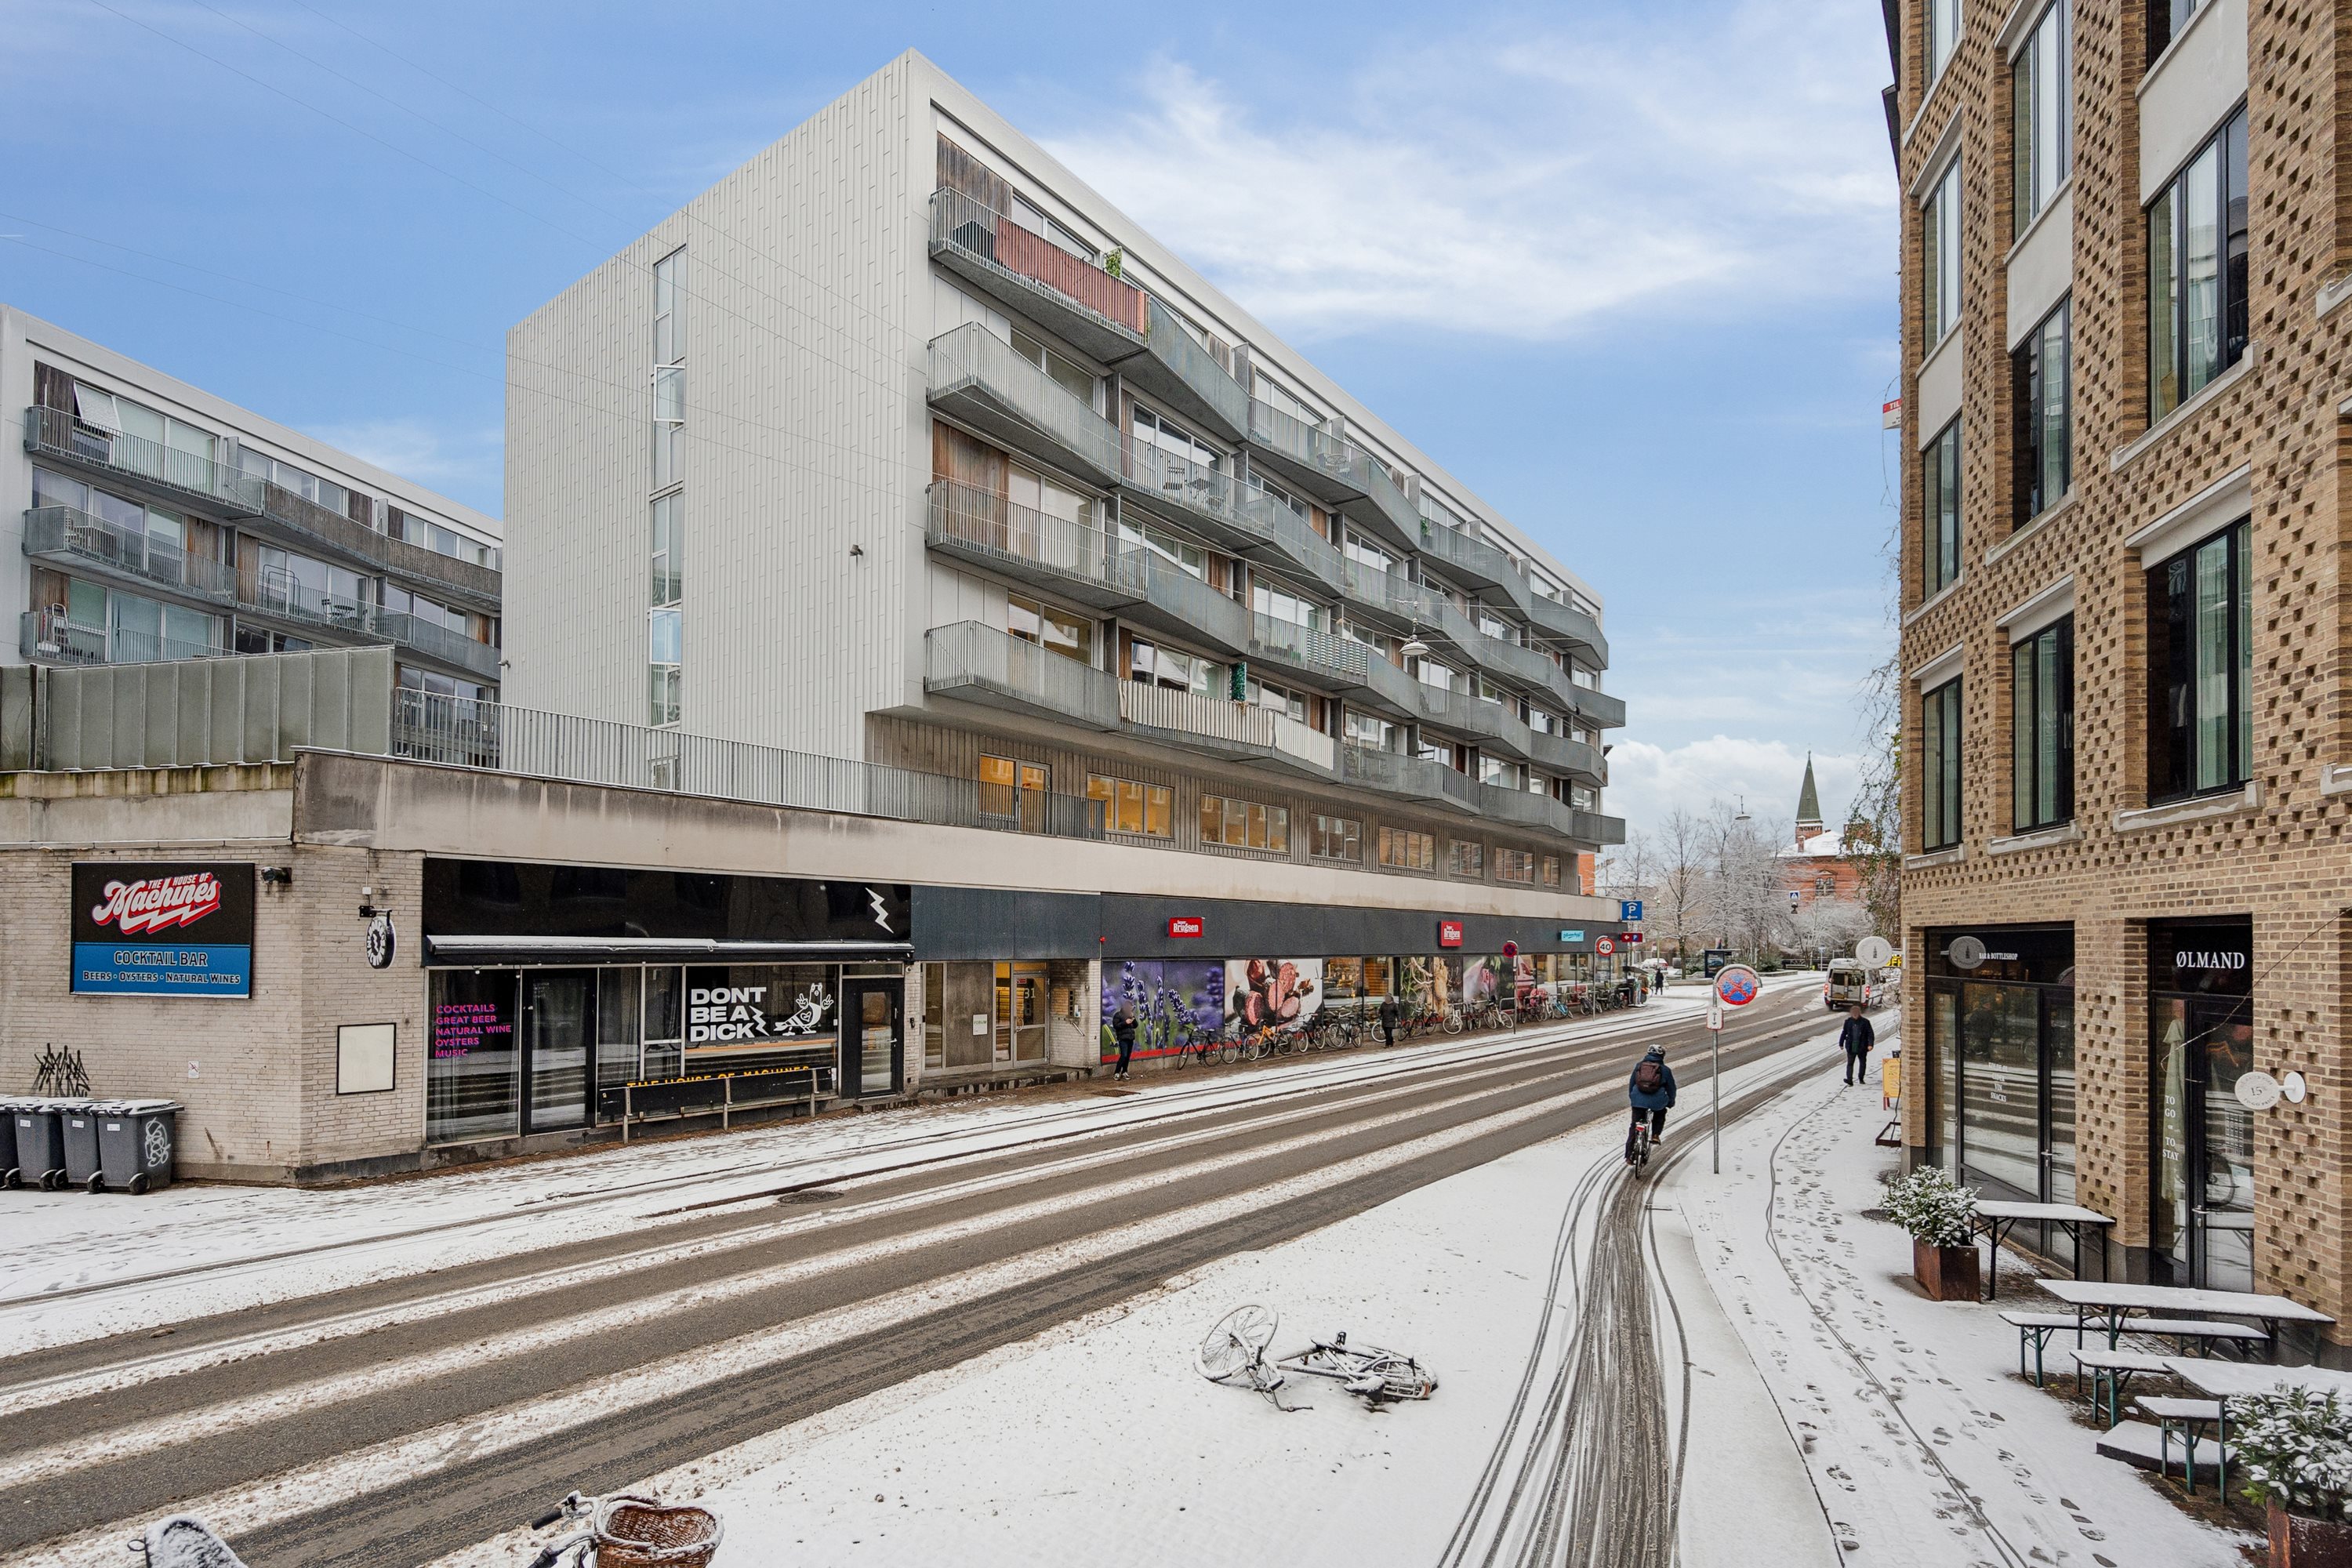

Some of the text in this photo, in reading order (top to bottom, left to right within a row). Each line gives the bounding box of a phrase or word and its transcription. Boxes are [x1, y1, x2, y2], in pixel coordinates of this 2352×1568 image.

[147, 872, 210, 890] THE HOUSE OF
[92, 877, 220, 931] Machines
[1628, 906, 1636, 914] P
[1173, 923, 1199, 933] Brugsen
[114, 950, 209, 967] COCKTAIL BAR
[2176, 951, 2245, 969] ØLMAND
[82, 971, 241, 984] BEERS OYSTERS NATURAL WINES
[691, 986, 767, 1005] DONT
[1024, 988, 1036, 999] 31
[436, 1004, 496, 1014] COCKTAILS
[691, 1005, 750, 1024] BE A
[436, 1015, 497, 1025] GREAT BEER
[436, 1025, 512, 1036] NATURAL WINE
[690, 1022, 756, 1043] DICK
[435, 1037, 480, 1047] OYSTERS
[435, 1049, 469, 1058] MUSIC
[2165, 1094, 2176, 1105] TO
[2165, 1108, 2176, 1118] GO
[2165, 1136, 2176, 1147] TO
[2162, 1149, 2180, 1161] STAY
